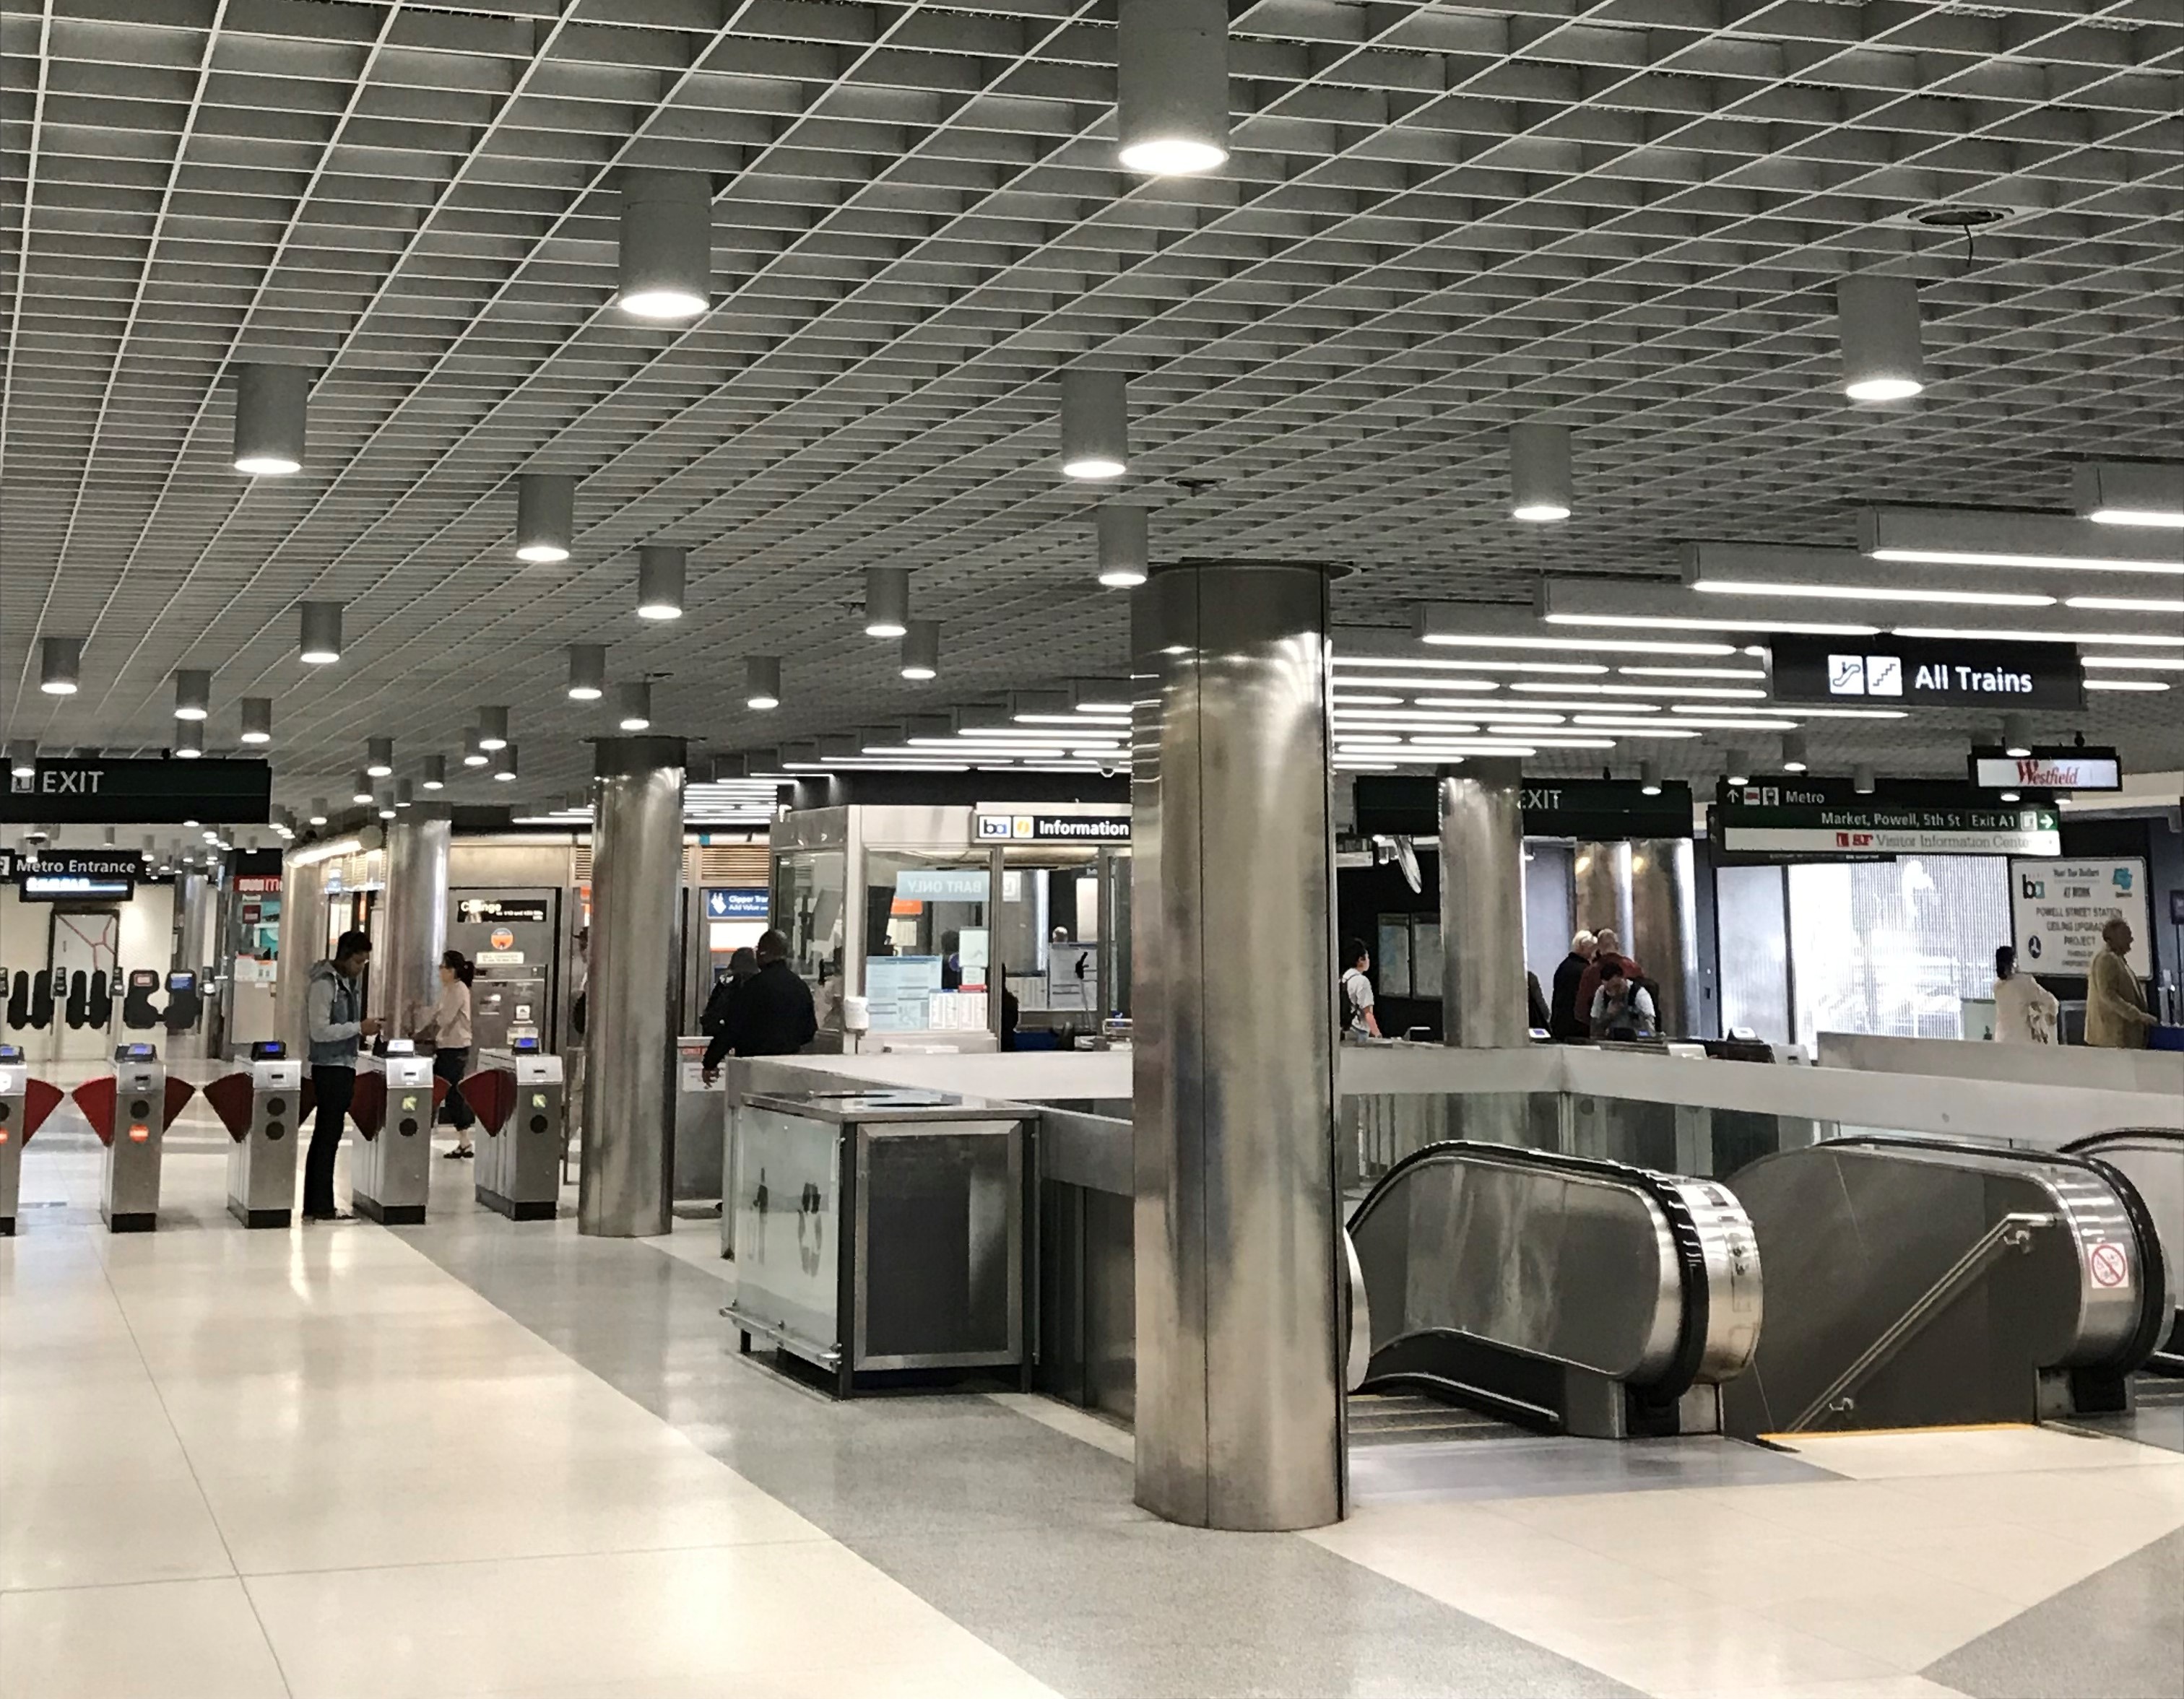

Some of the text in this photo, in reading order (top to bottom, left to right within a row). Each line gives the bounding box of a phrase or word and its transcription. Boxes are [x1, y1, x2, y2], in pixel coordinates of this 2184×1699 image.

[1915, 664, 2033, 693] All Trains
[2017, 759, 2079, 786] Westfield
[42, 770, 105, 794] EXIT
[1785, 790, 1825, 804] Metro
[1821, 812, 2015, 827] Market, Powell, 5th St Exit A1
[1039, 820, 1130, 835] Information
[1876, 834, 1915, 848] Visitor
[1920, 834, 1990, 848] Information
[17, 859, 136, 873] Metro Entrance
[461, 901, 502, 914] Cnge
